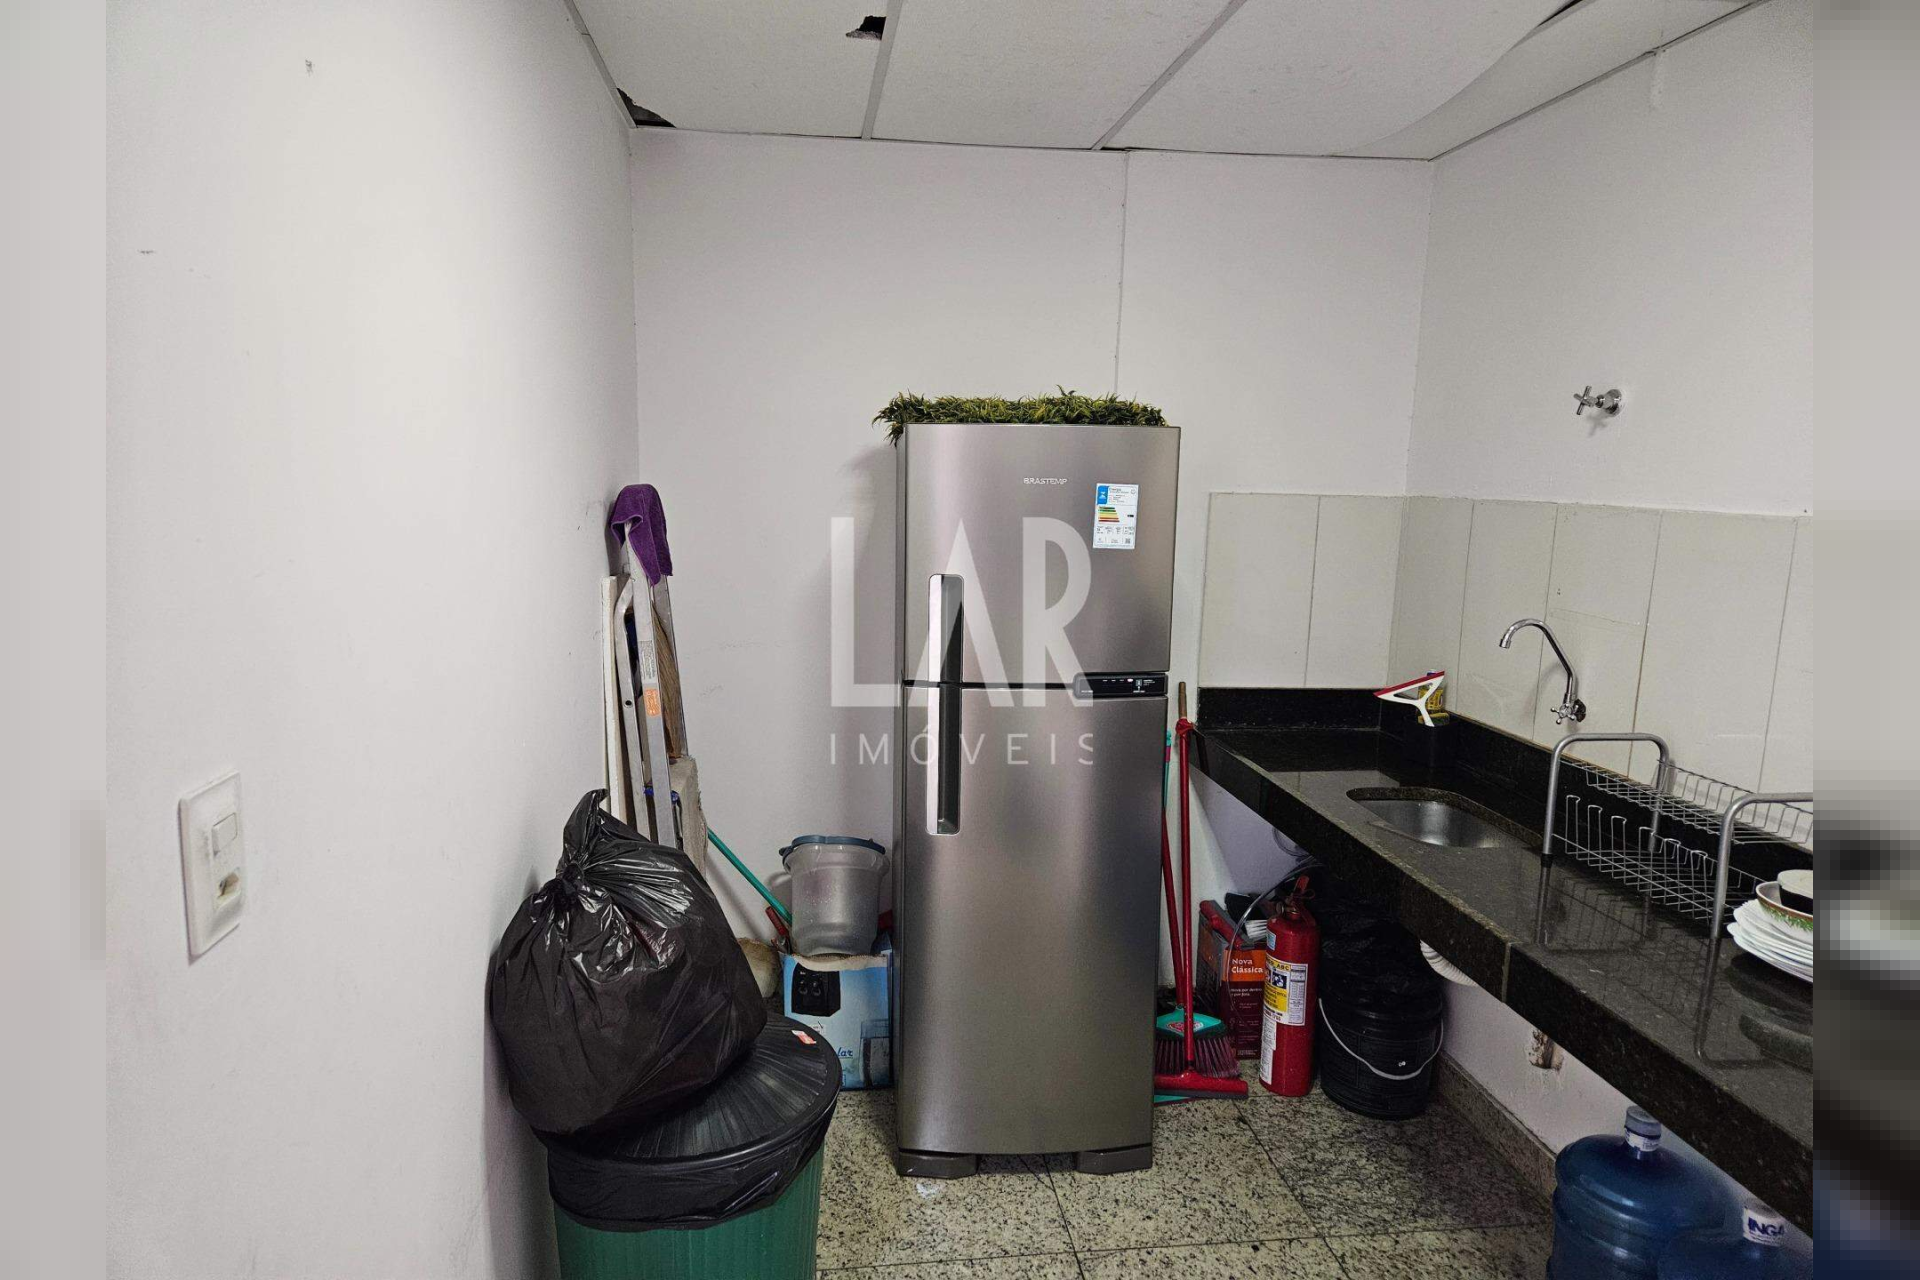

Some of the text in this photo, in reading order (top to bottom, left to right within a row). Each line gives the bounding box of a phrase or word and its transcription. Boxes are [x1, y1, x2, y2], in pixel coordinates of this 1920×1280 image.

[1023, 477, 1069, 485] BRASTEMP
[1231, 957, 1253, 965] Nova
[1231, 965, 1264, 974] Clássica
